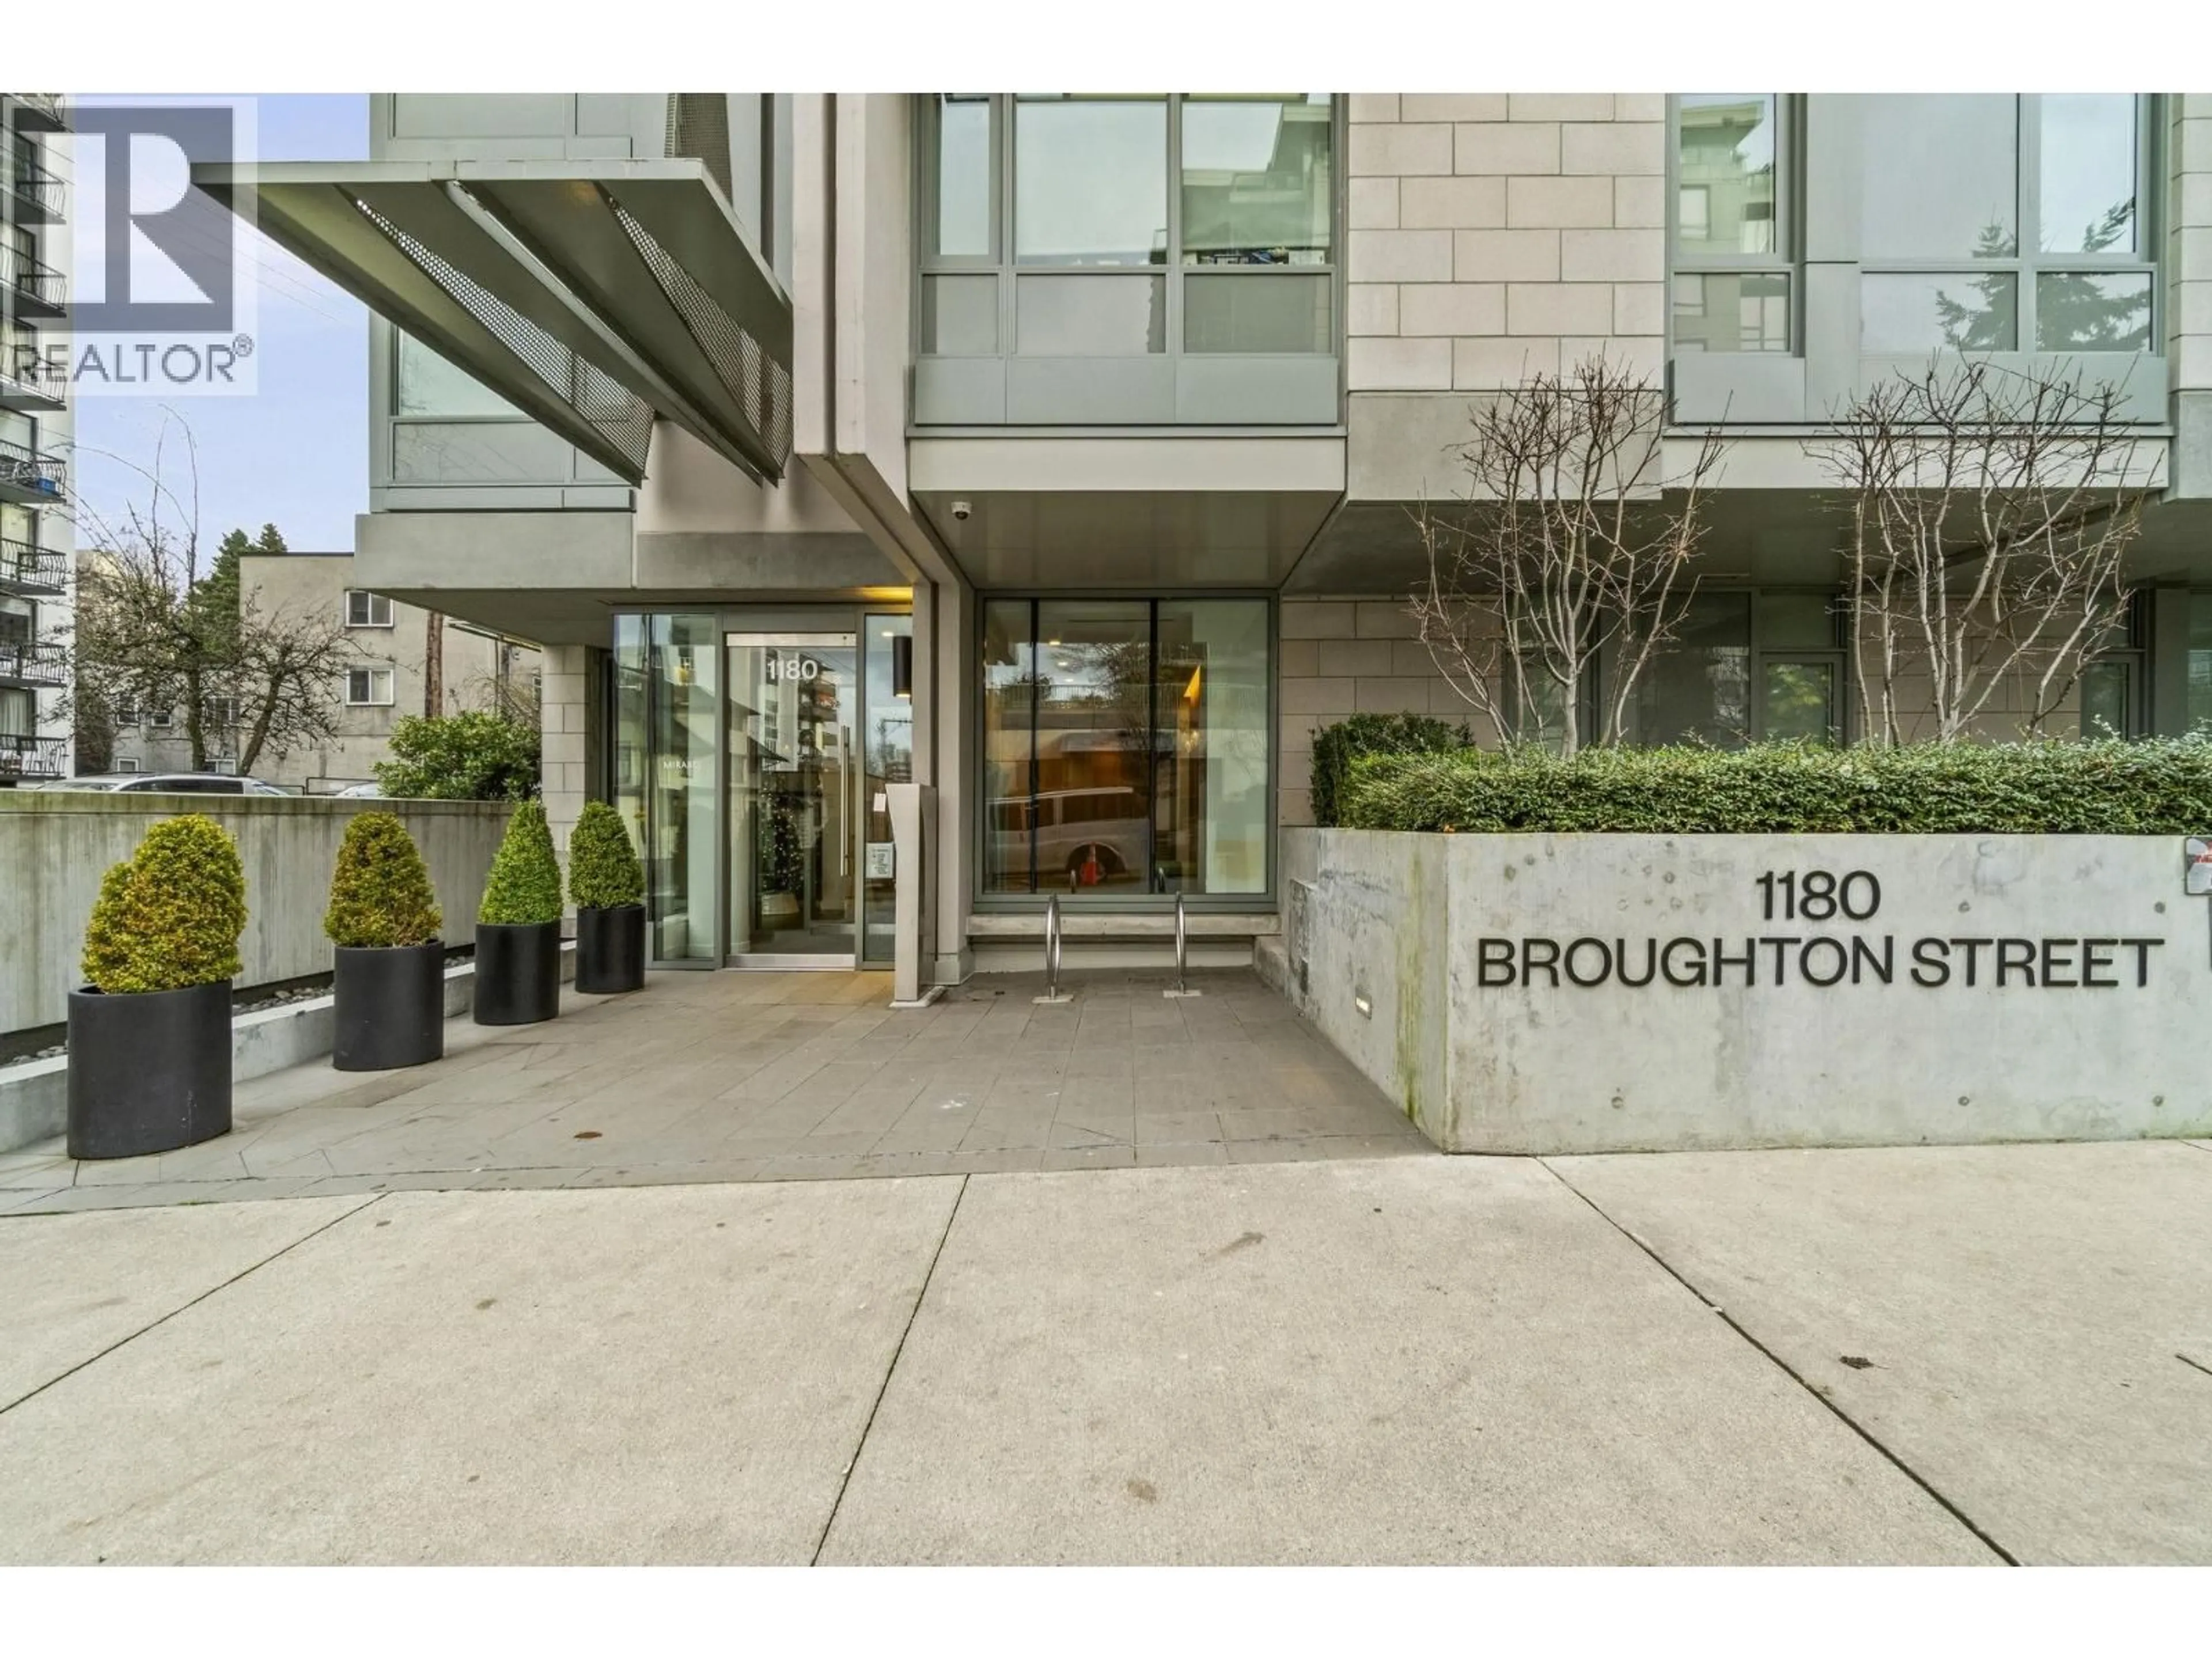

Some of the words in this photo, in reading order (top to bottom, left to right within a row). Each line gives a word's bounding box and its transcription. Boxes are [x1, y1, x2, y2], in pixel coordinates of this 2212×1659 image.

[767, 660, 818, 680] 1180
[1755, 870, 1881, 921] 1180
[1478, 935, 1893, 987] BROUGHTON
[1910, 937, 2165, 987] STREET
